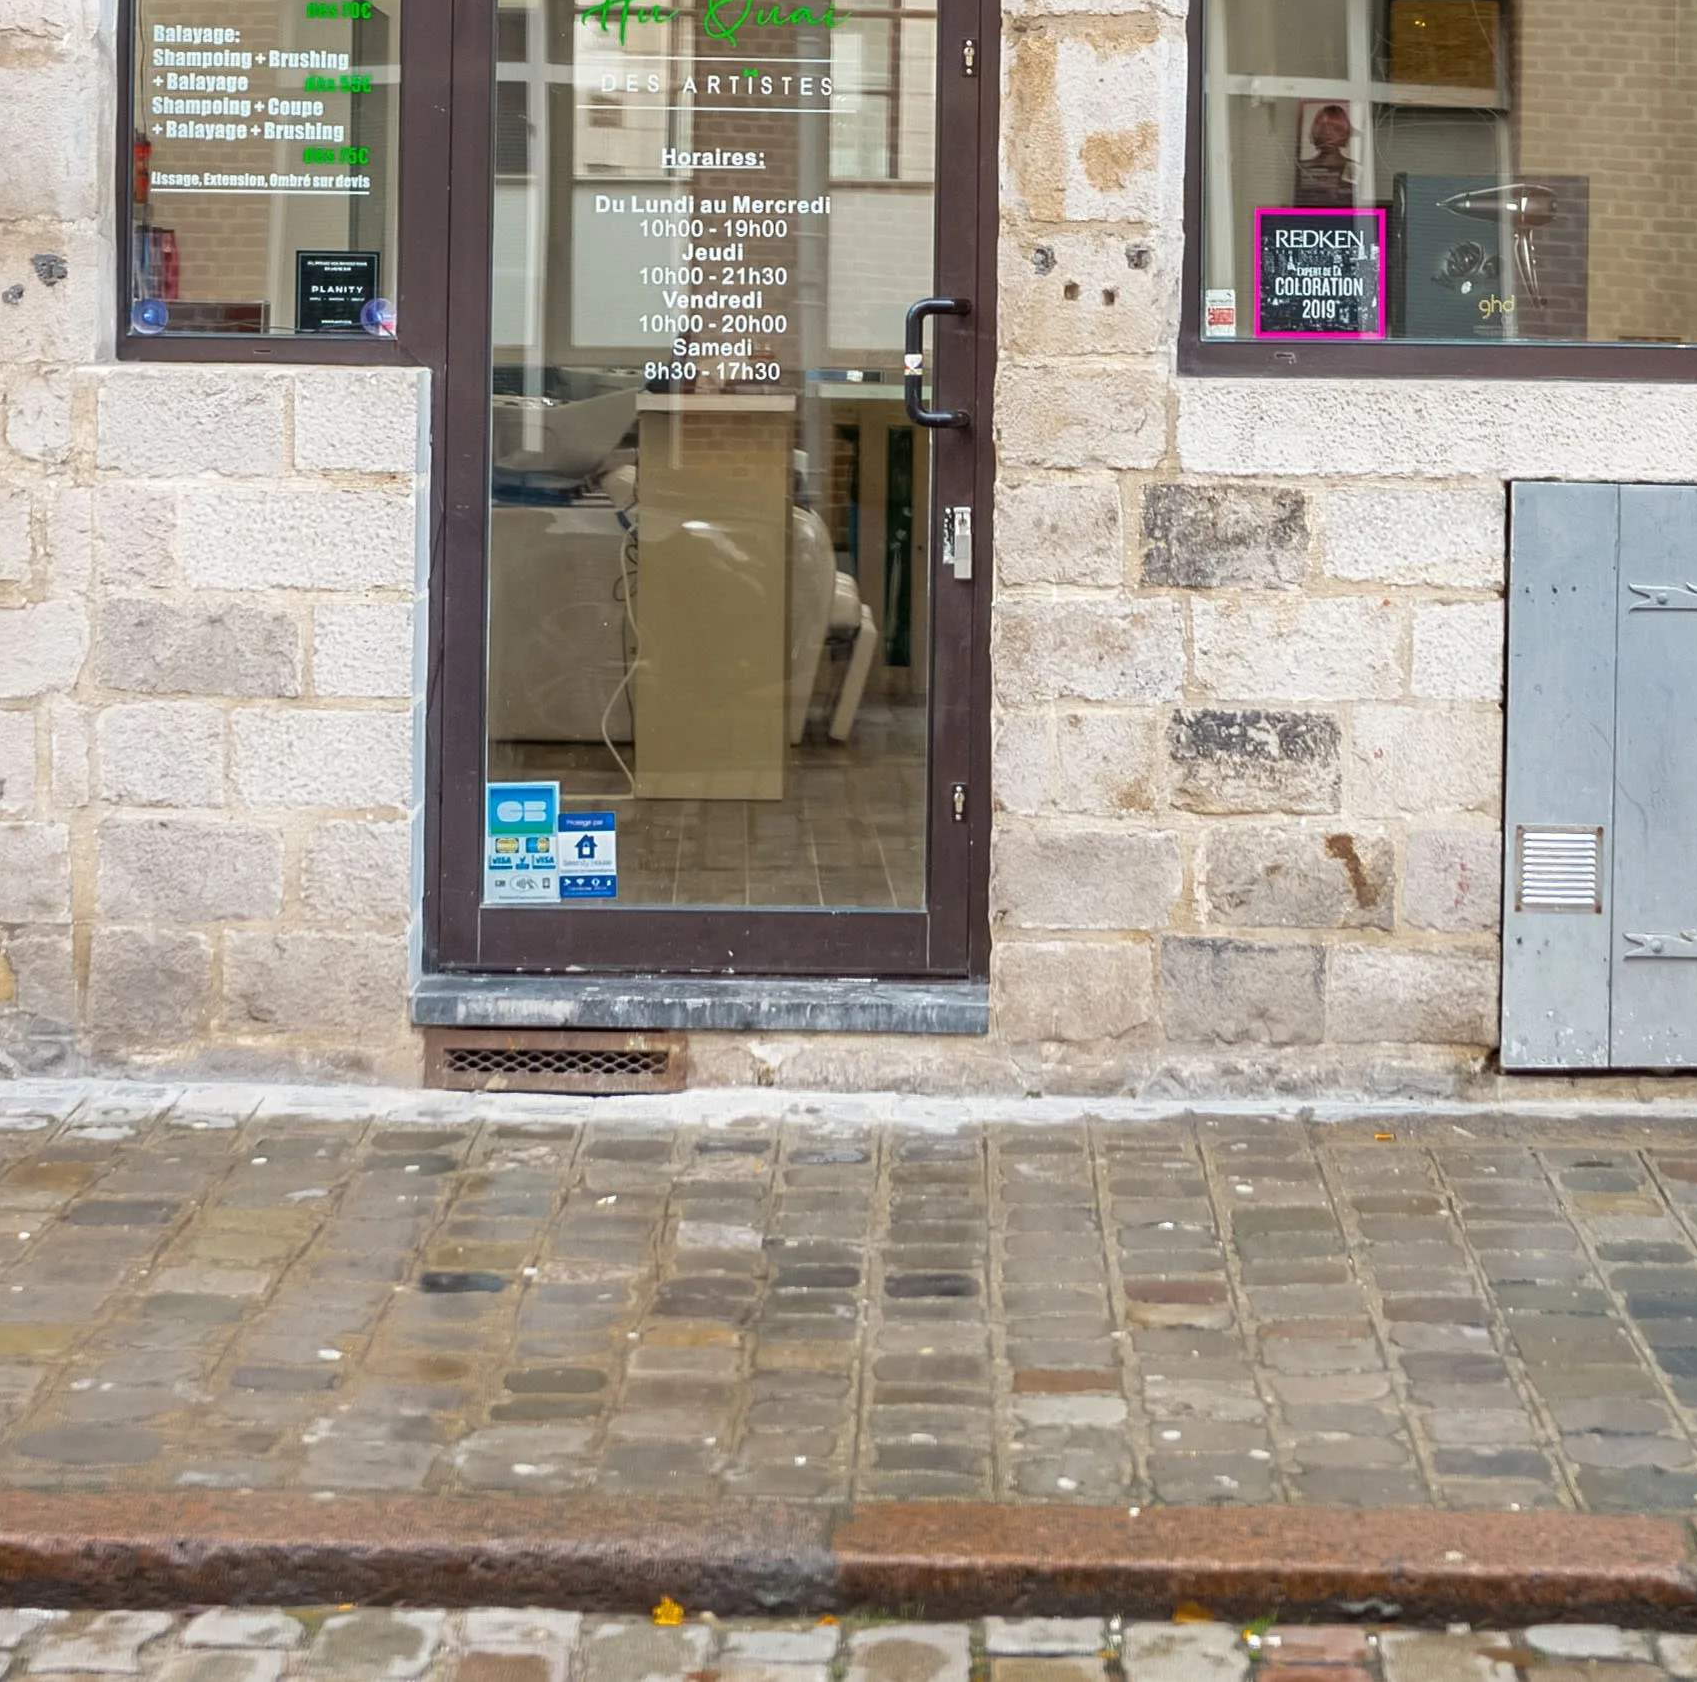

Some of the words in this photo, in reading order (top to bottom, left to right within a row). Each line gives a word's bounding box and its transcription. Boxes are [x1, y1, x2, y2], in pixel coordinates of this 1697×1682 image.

[153, 25, 241, 46] Balayage:
[153, 49, 253, 70] Shampoing
[255, 53, 266, 65] +
[269, 50, 350, 71] Brushing
[153, 76, 164, 88] +
[166, 73, 249, 94] Balayage
[601, 74, 660, 94] DES
[683, 70, 834, 96] ARTISTES
[152, 97, 251, 118] Shampoing
[254, 101, 265, 113] +
[267, 98, 324, 118] Coupe
[152, 123, 163, 135] +
[166, 121, 247, 142] Balayage
[250, 125, 261, 137] +
[264, 122, 345, 143] Brushing
[661, 148, 766, 170] Horaires:
[151, 172, 202, 189] Lissage,
[204, 172, 268, 189] Extension,
[270, 171, 311, 188] Ombré
[313, 175, 334, 188] sur
[335, 173, 370, 189] devis
[595, 195, 626, 215] Du
[631, 195, 695, 215] Lundi
[700, 199, 728, 215] au
[732, 195, 832, 215] Mercredi
[639, 219, 704, 238] 10h00
[723, 219, 788, 238] 19h00
[1275, 229, 1365, 249] REDKEN
[681, 243, 744, 262] Jeudi
[639, 267, 704, 286] 10h00
[722, 267, 788, 286] 21h30
[311, 285, 364, 295] PLANITY
[1275, 277, 1365, 297] COLORATION
[662, 290, 763, 310] Vendredi
[1302, 299, 1336, 319] 2019
[1478, 294, 1516, 320] ghd
[639, 314, 704, 334] 10h00
[722, 314, 788, 334] 20h00
[671, 338, 754, 358] Samedi
[644, 362, 698, 381] 8h30
[716, 362, 781, 381] 17h30
